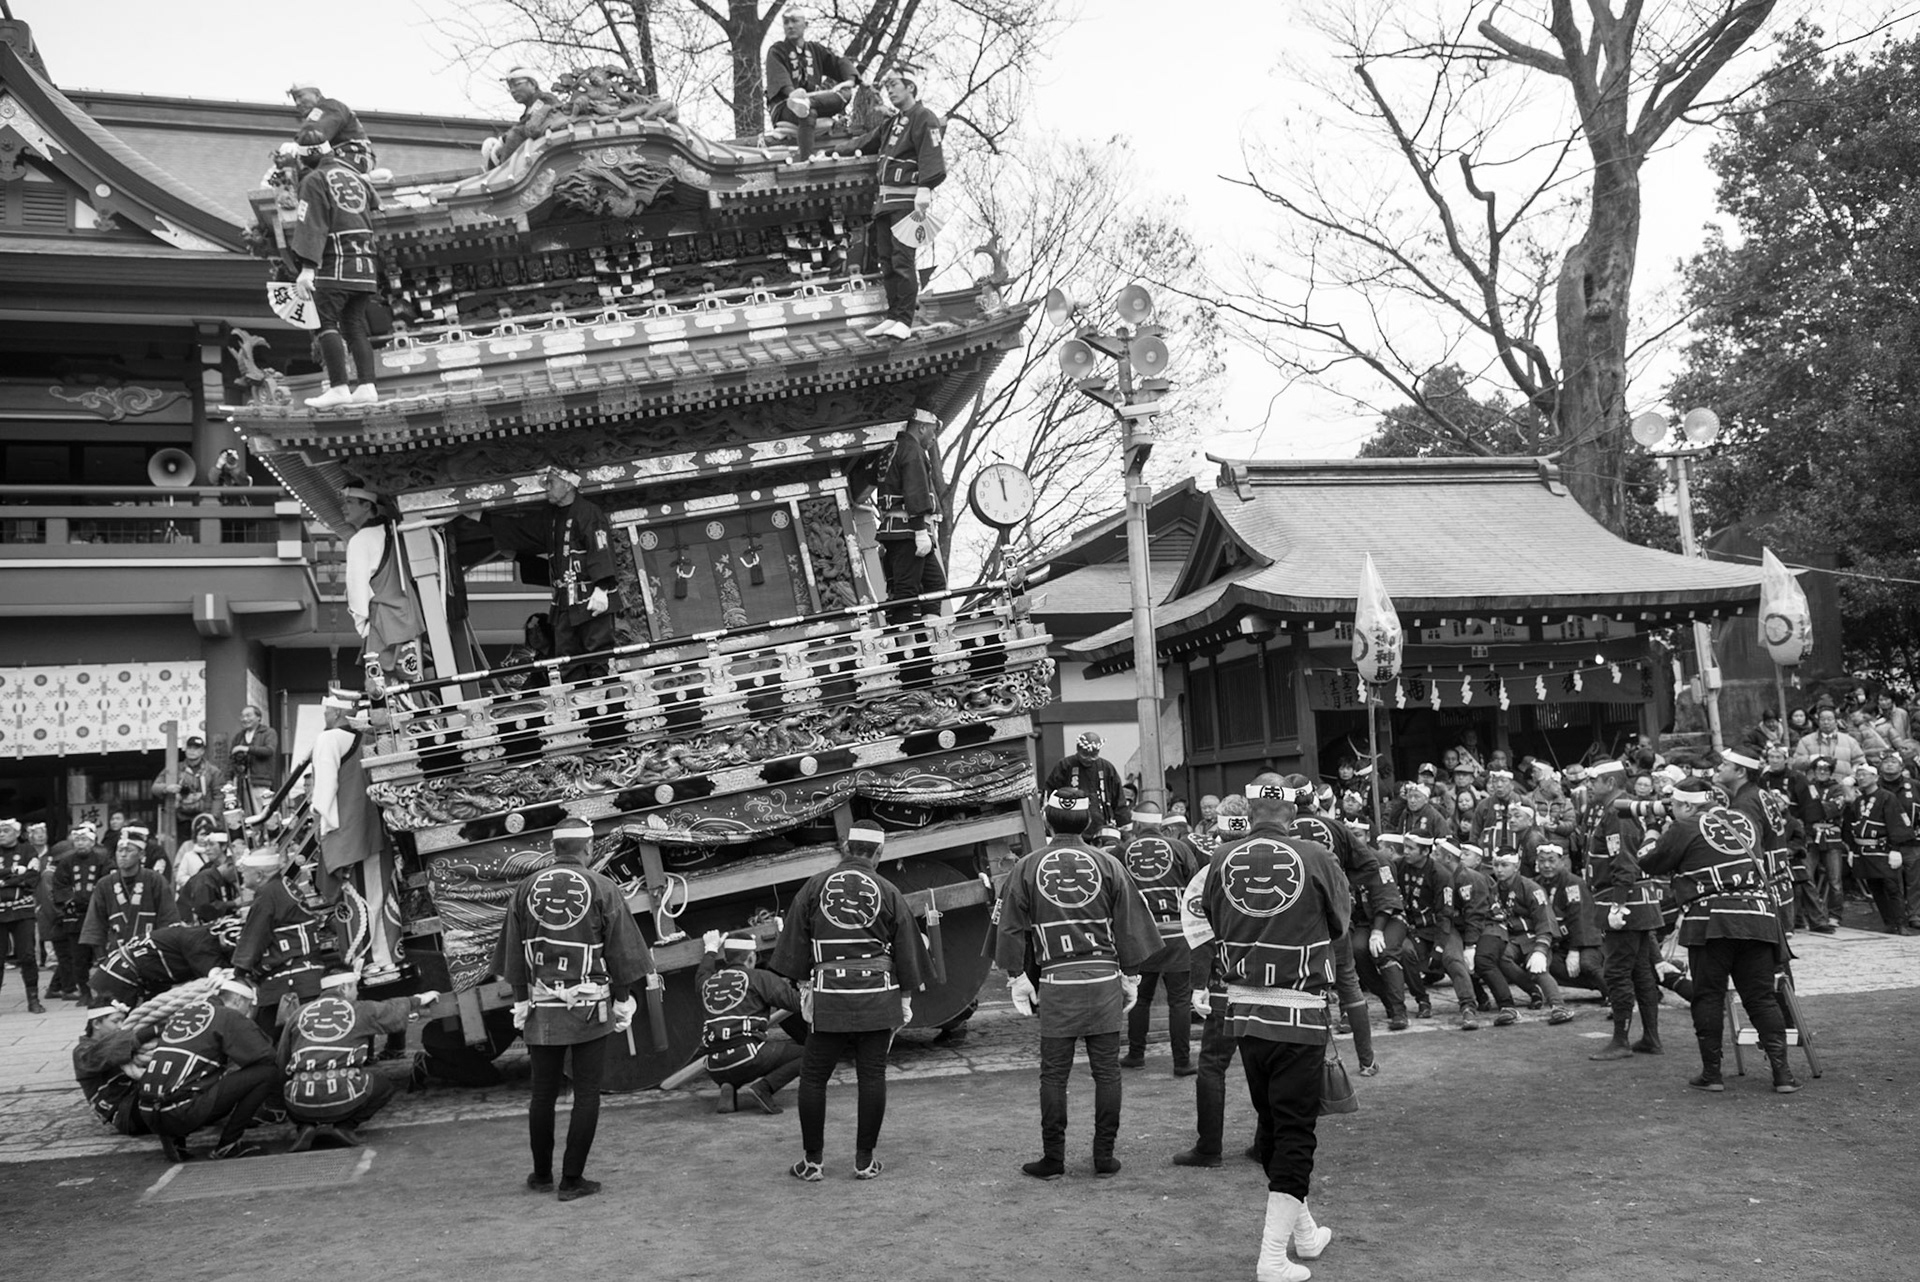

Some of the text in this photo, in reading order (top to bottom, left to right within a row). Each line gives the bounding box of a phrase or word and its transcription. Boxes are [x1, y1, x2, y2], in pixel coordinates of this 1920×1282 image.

[999, 468, 1007, 476] 12
[982, 480, 990, 488] 10
[1019, 479, 1025, 487] 2
[980, 491, 985, 499] 9
[1023, 489, 1029, 498] 3
[984, 502, 990, 510] 8
[1003, 512, 1009, 520] 6
[1013, 509, 1019, 517] 5
